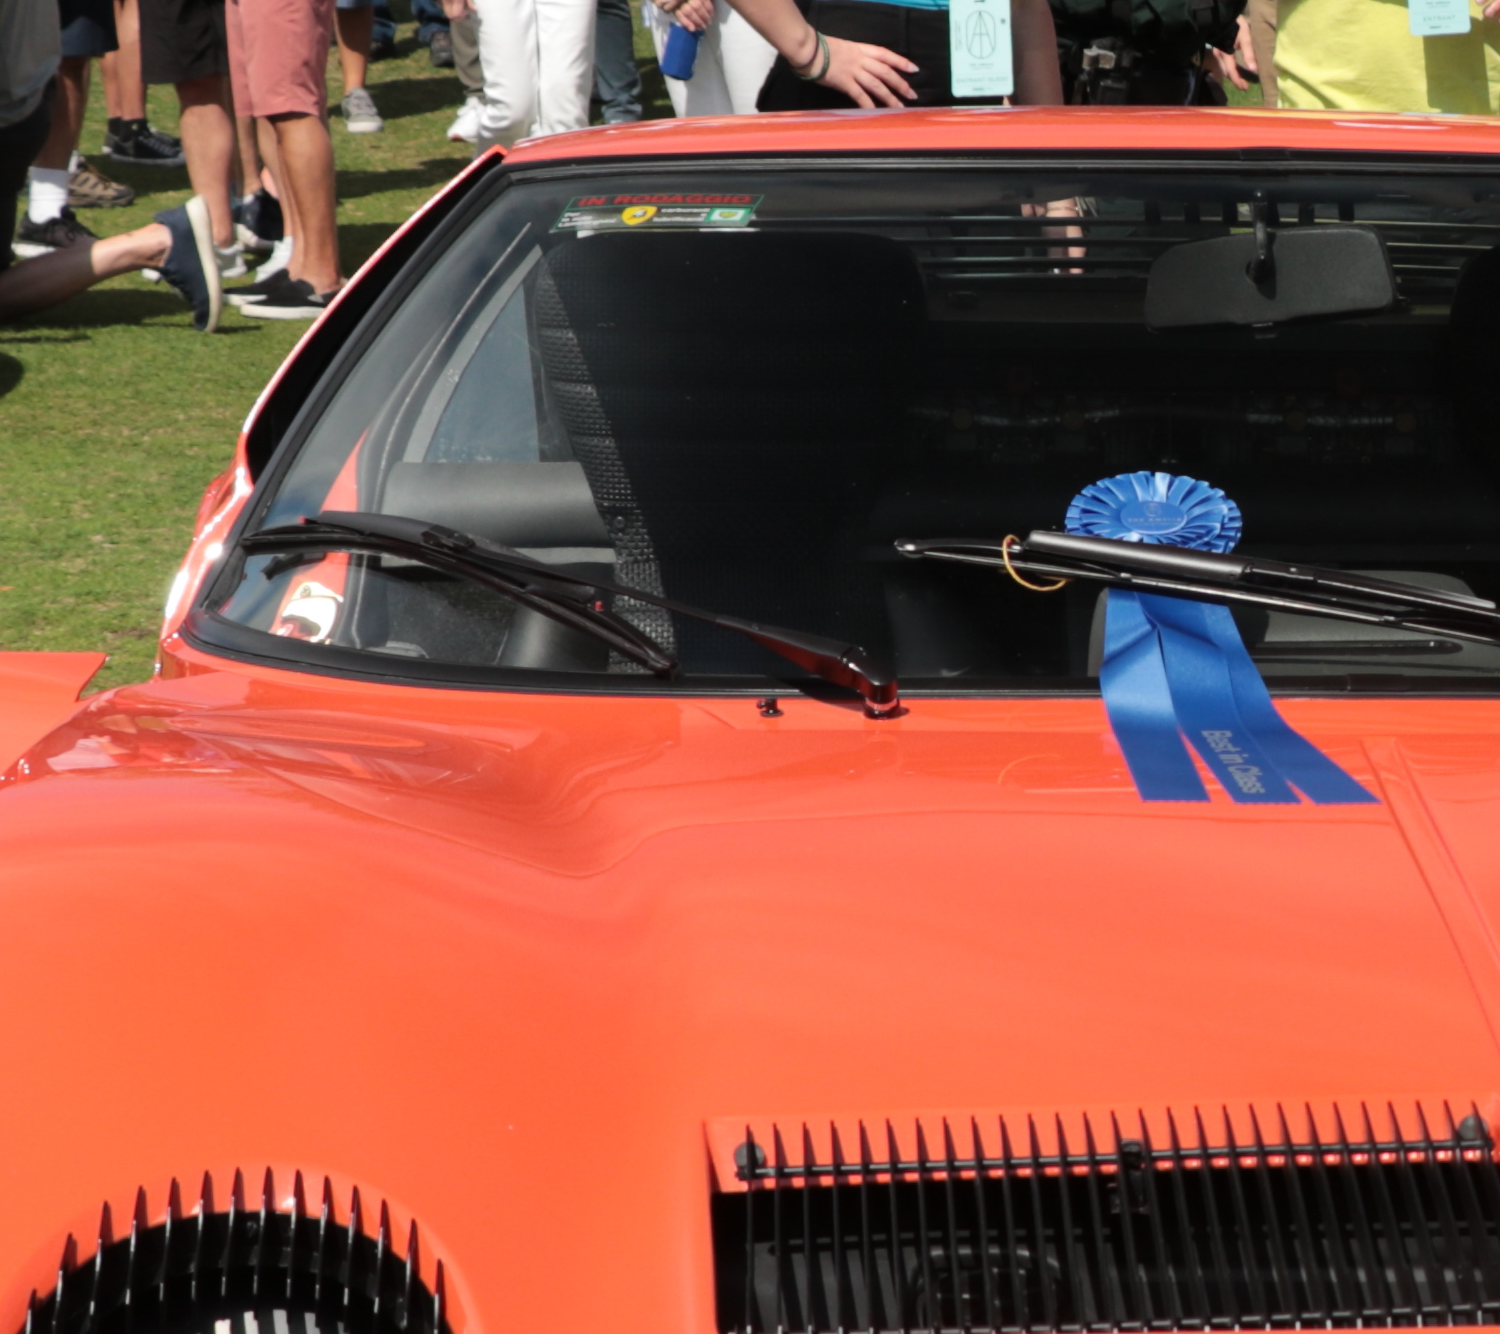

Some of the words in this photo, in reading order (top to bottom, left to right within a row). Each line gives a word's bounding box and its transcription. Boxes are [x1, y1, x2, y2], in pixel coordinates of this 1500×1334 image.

[578, 196, 607, 207] IN
[613, 193, 752, 205] RODAGGIO
[1200, 729, 1242, 753] Best
[1218, 753, 1250, 764] in
[1227, 765, 1267, 794] Class
